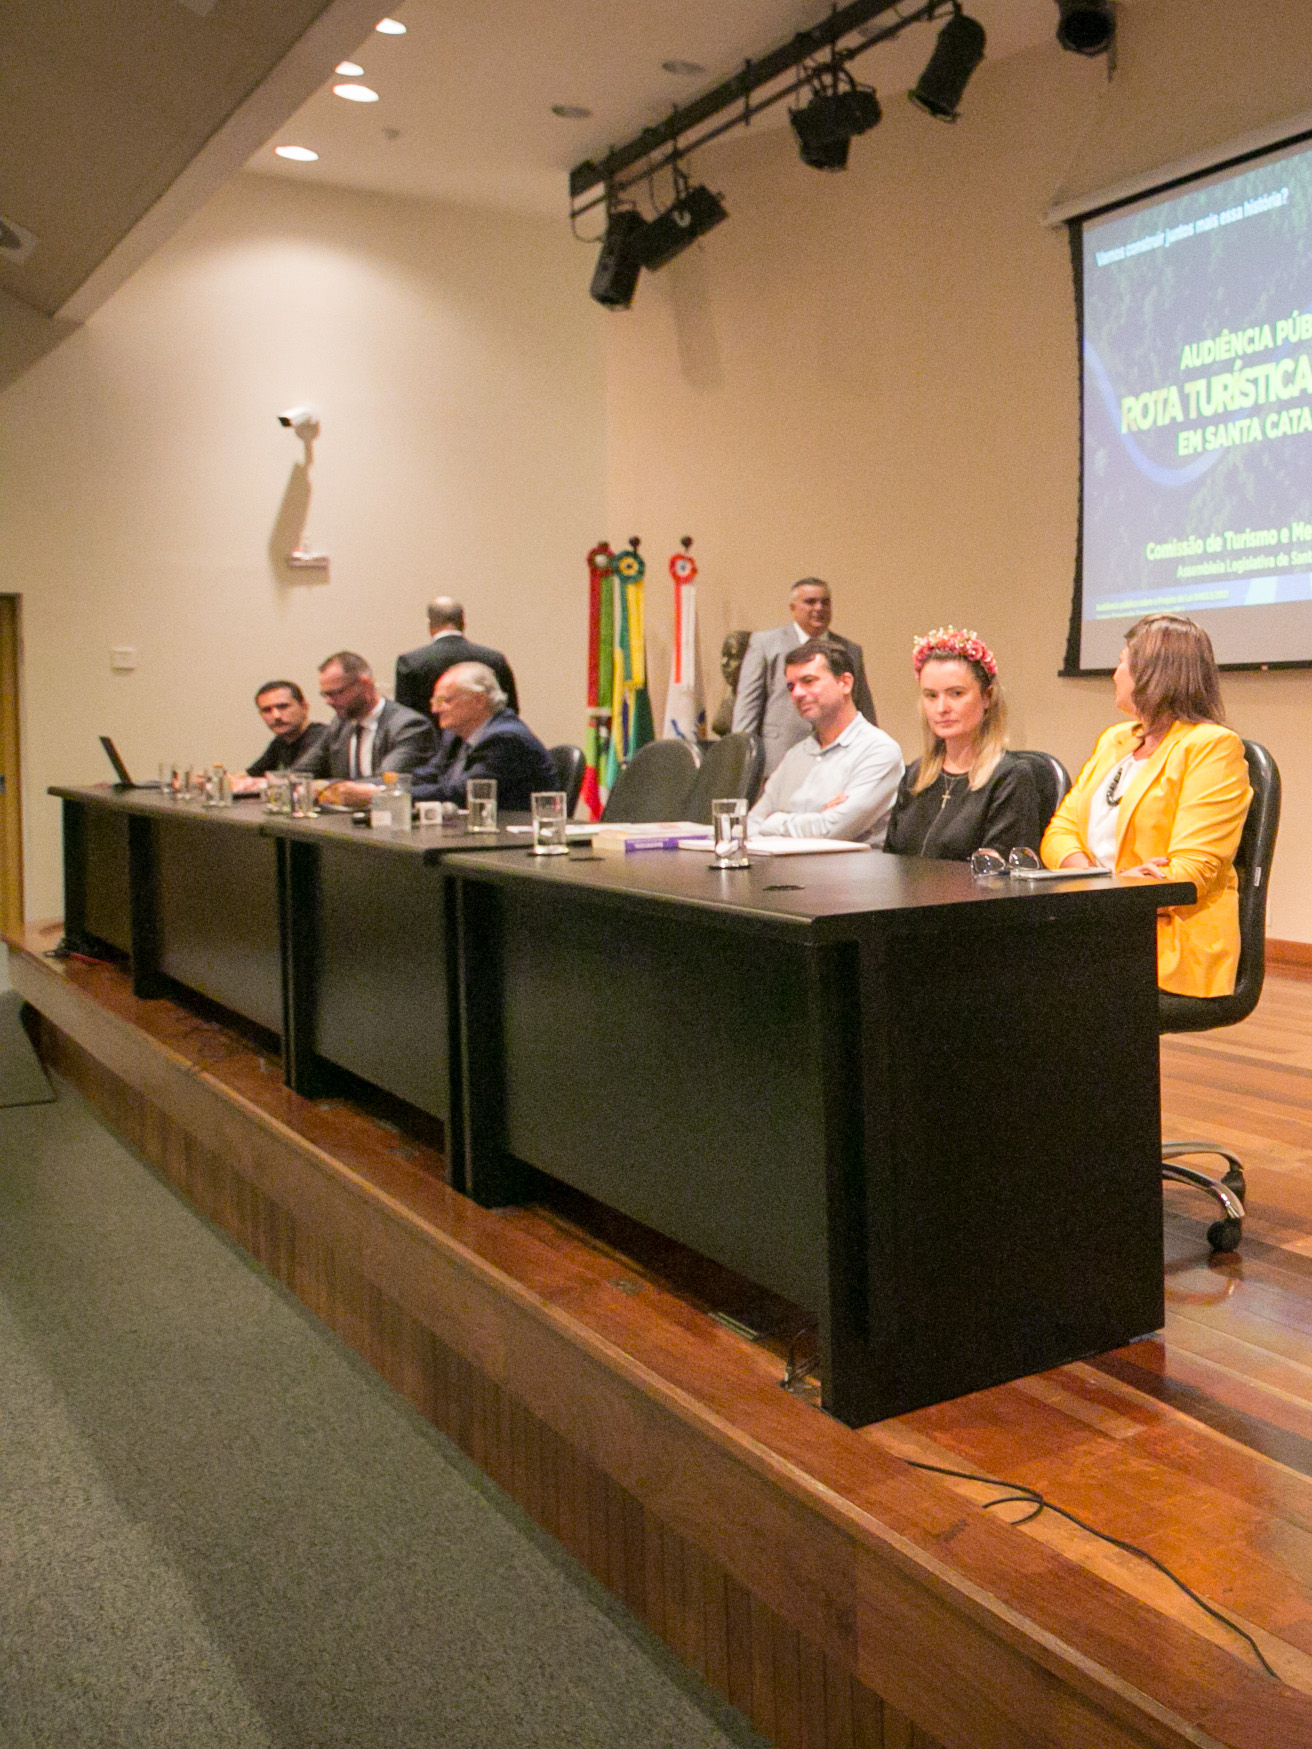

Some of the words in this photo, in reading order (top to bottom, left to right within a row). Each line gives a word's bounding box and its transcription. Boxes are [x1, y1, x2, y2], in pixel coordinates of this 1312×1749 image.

[1164, 222, 1195, 248] juntos
[1195, 213, 1219, 234] mais
[1219, 206, 1244, 226] essa
[1243, 186, 1289, 218] história?
[1179, 328, 1273, 370] AUDIÊNCIA
[1120, 385, 1184, 434] ROTA
[1177, 428, 1203, 457] EM
[1204, 416, 1263, 452] SANTA
[1145, 535, 1204, 561] Comissão
[1204, 532, 1223, 553] de
[1223, 528, 1278, 550] Turismo
[1279, 527, 1290, 544] e
[1176, 560, 1225, 578] Assembleia
[1226, 554, 1276, 574] Legislativa
[1275, 552, 1290, 567] de
